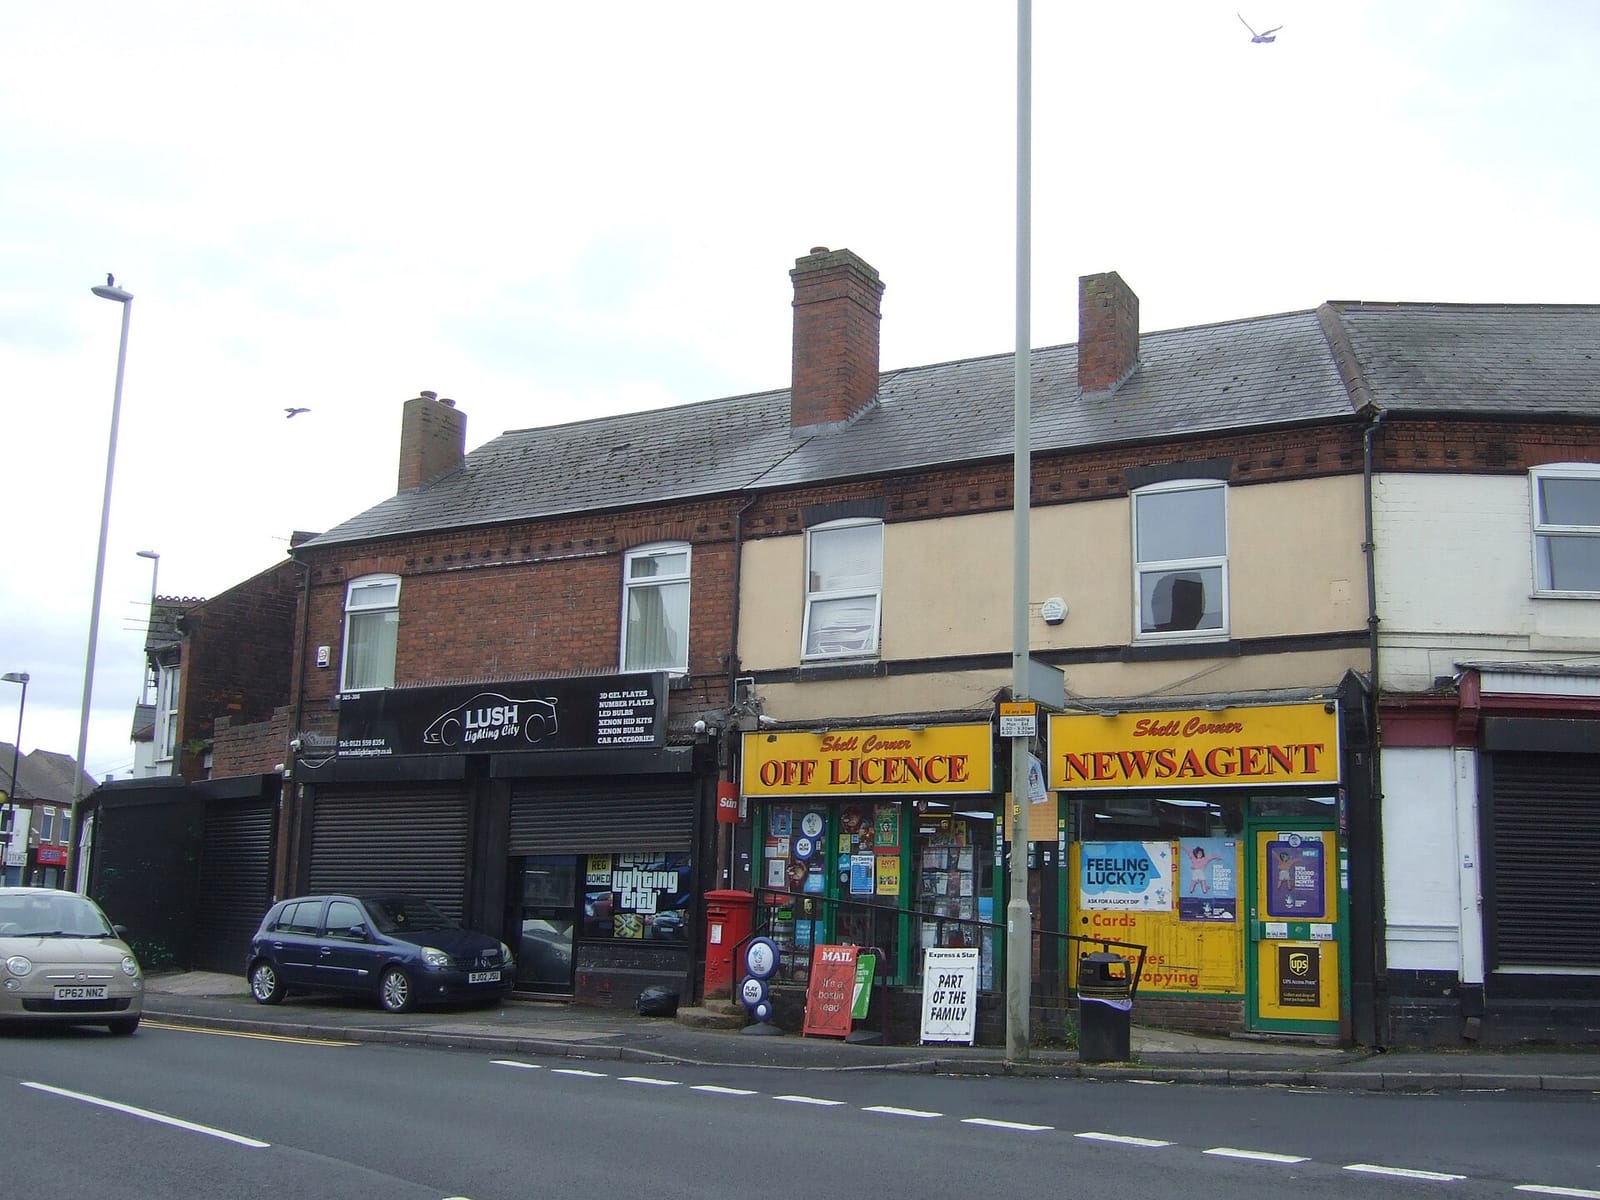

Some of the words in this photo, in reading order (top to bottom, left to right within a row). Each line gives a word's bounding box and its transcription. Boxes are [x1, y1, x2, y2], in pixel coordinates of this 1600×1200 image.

[622, 690, 648, 698] PLATES
[599, 700, 628, 708] NUMBER
[466, 704, 518, 729] LUSH
[612, 708, 634, 716] BULBS
[464, 728, 500, 743] Lighting
[501, 724, 520, 737] City
[622, 726, 645, 734] BULBS
[1133, 719, 1181, 738] Shell
[1183, 716, 1243, 738] Corner
[820, 736, 858, 752] Shell
[861, 735, 911, 753] Corner
[1063, 743, 1325, 781] NEWSAGENT
[760, 759, 818, 786] OFF
[829, 755, 970, 785] LICENCE
[592, 860, 607, 870] REG
[1087, 857, 1149, 872] FEELING
[612, 867, 678, 893] Lighting
[1087, 872, 1147, 885] LUCKY?
[1093, 914, 1137, 927] Cards
[822, 951, 853, 962] MAIL
[1291, 960, 1307, 972] ups
[938, 974, 964, 989] PART
[58, 988, 84, 998] CP62
[85, 988, 105, 998] NNZ
[932, 991, 946, 1004] OF
[948, 991, 967, 1004] THE
[820, 1002, 841, 1012] ead
[930, 1006, 967, 1021] FAMILY
